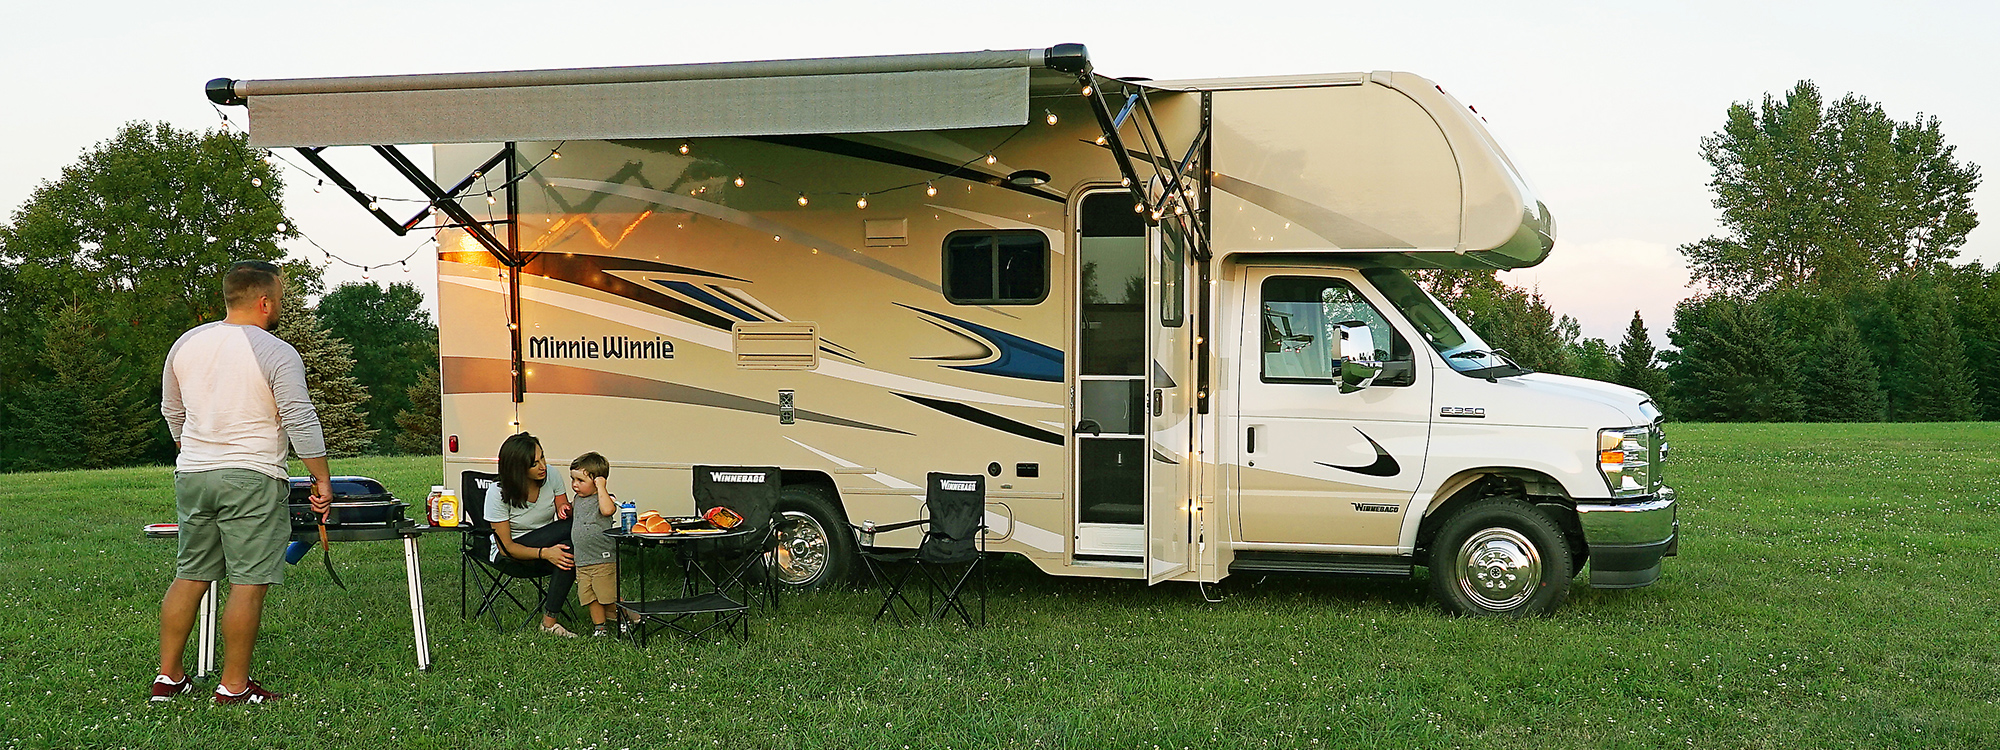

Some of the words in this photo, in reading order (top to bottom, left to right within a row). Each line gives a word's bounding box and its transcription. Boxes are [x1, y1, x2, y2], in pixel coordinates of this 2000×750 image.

[529, 335, 599, 359] Minnie
[602, 335, 675, 359] Winnie
[709, 471, 766, 483] WINNEBAGO
[1351, 502, 1400, 513] WINNEBAGO
